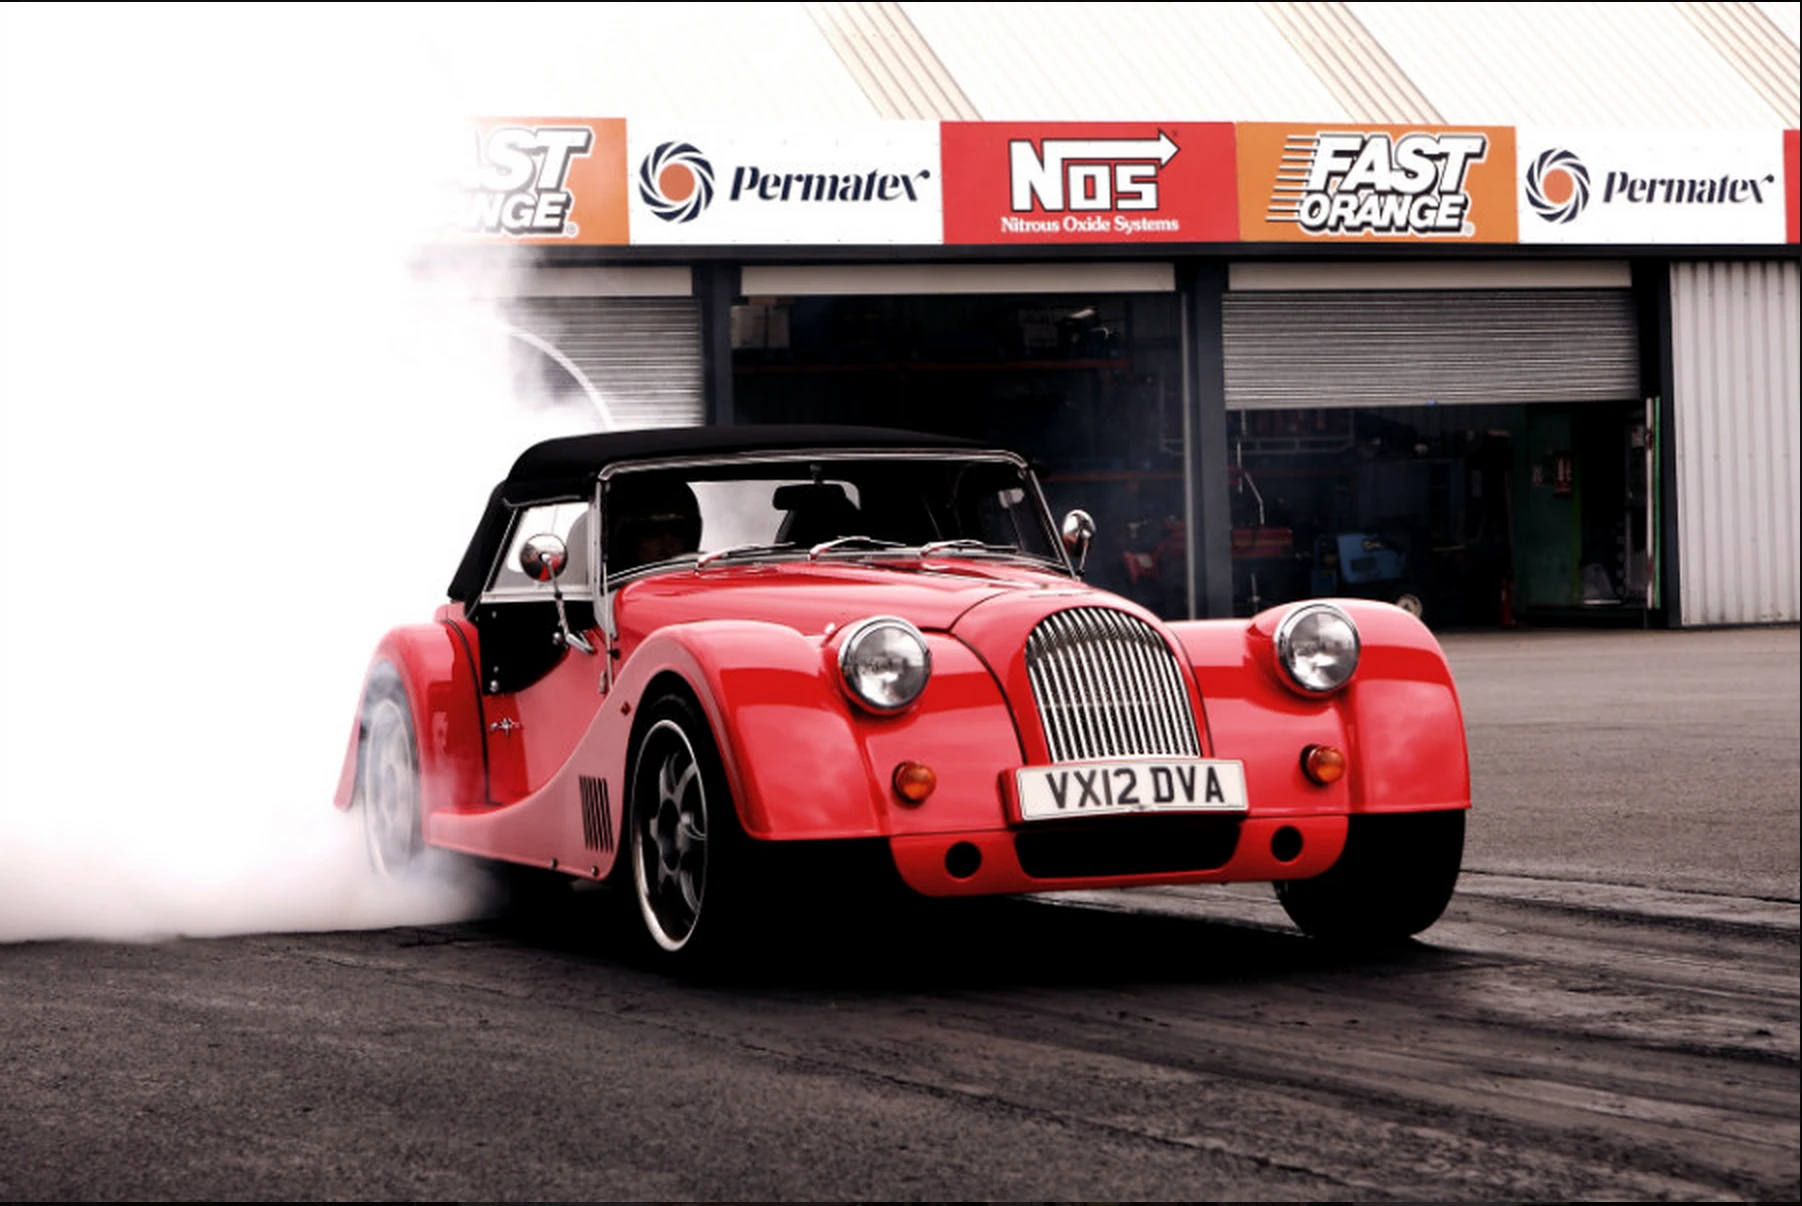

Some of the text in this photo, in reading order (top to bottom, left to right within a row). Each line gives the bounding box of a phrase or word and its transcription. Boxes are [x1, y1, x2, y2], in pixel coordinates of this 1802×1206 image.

[1009, 138, 1162, 212] NOS
[1309, 131, 1486, 193] FAST
[730, 166, 930, 202] Permatex
[1603, 171, 1775, 204] Permatex
[1001, 215, 1179, 235] Nitrous Oxide Systems
[1299, 190, 1467, 234] ORANGE
[1046, 766, 1225, 809] VX12 DVA
